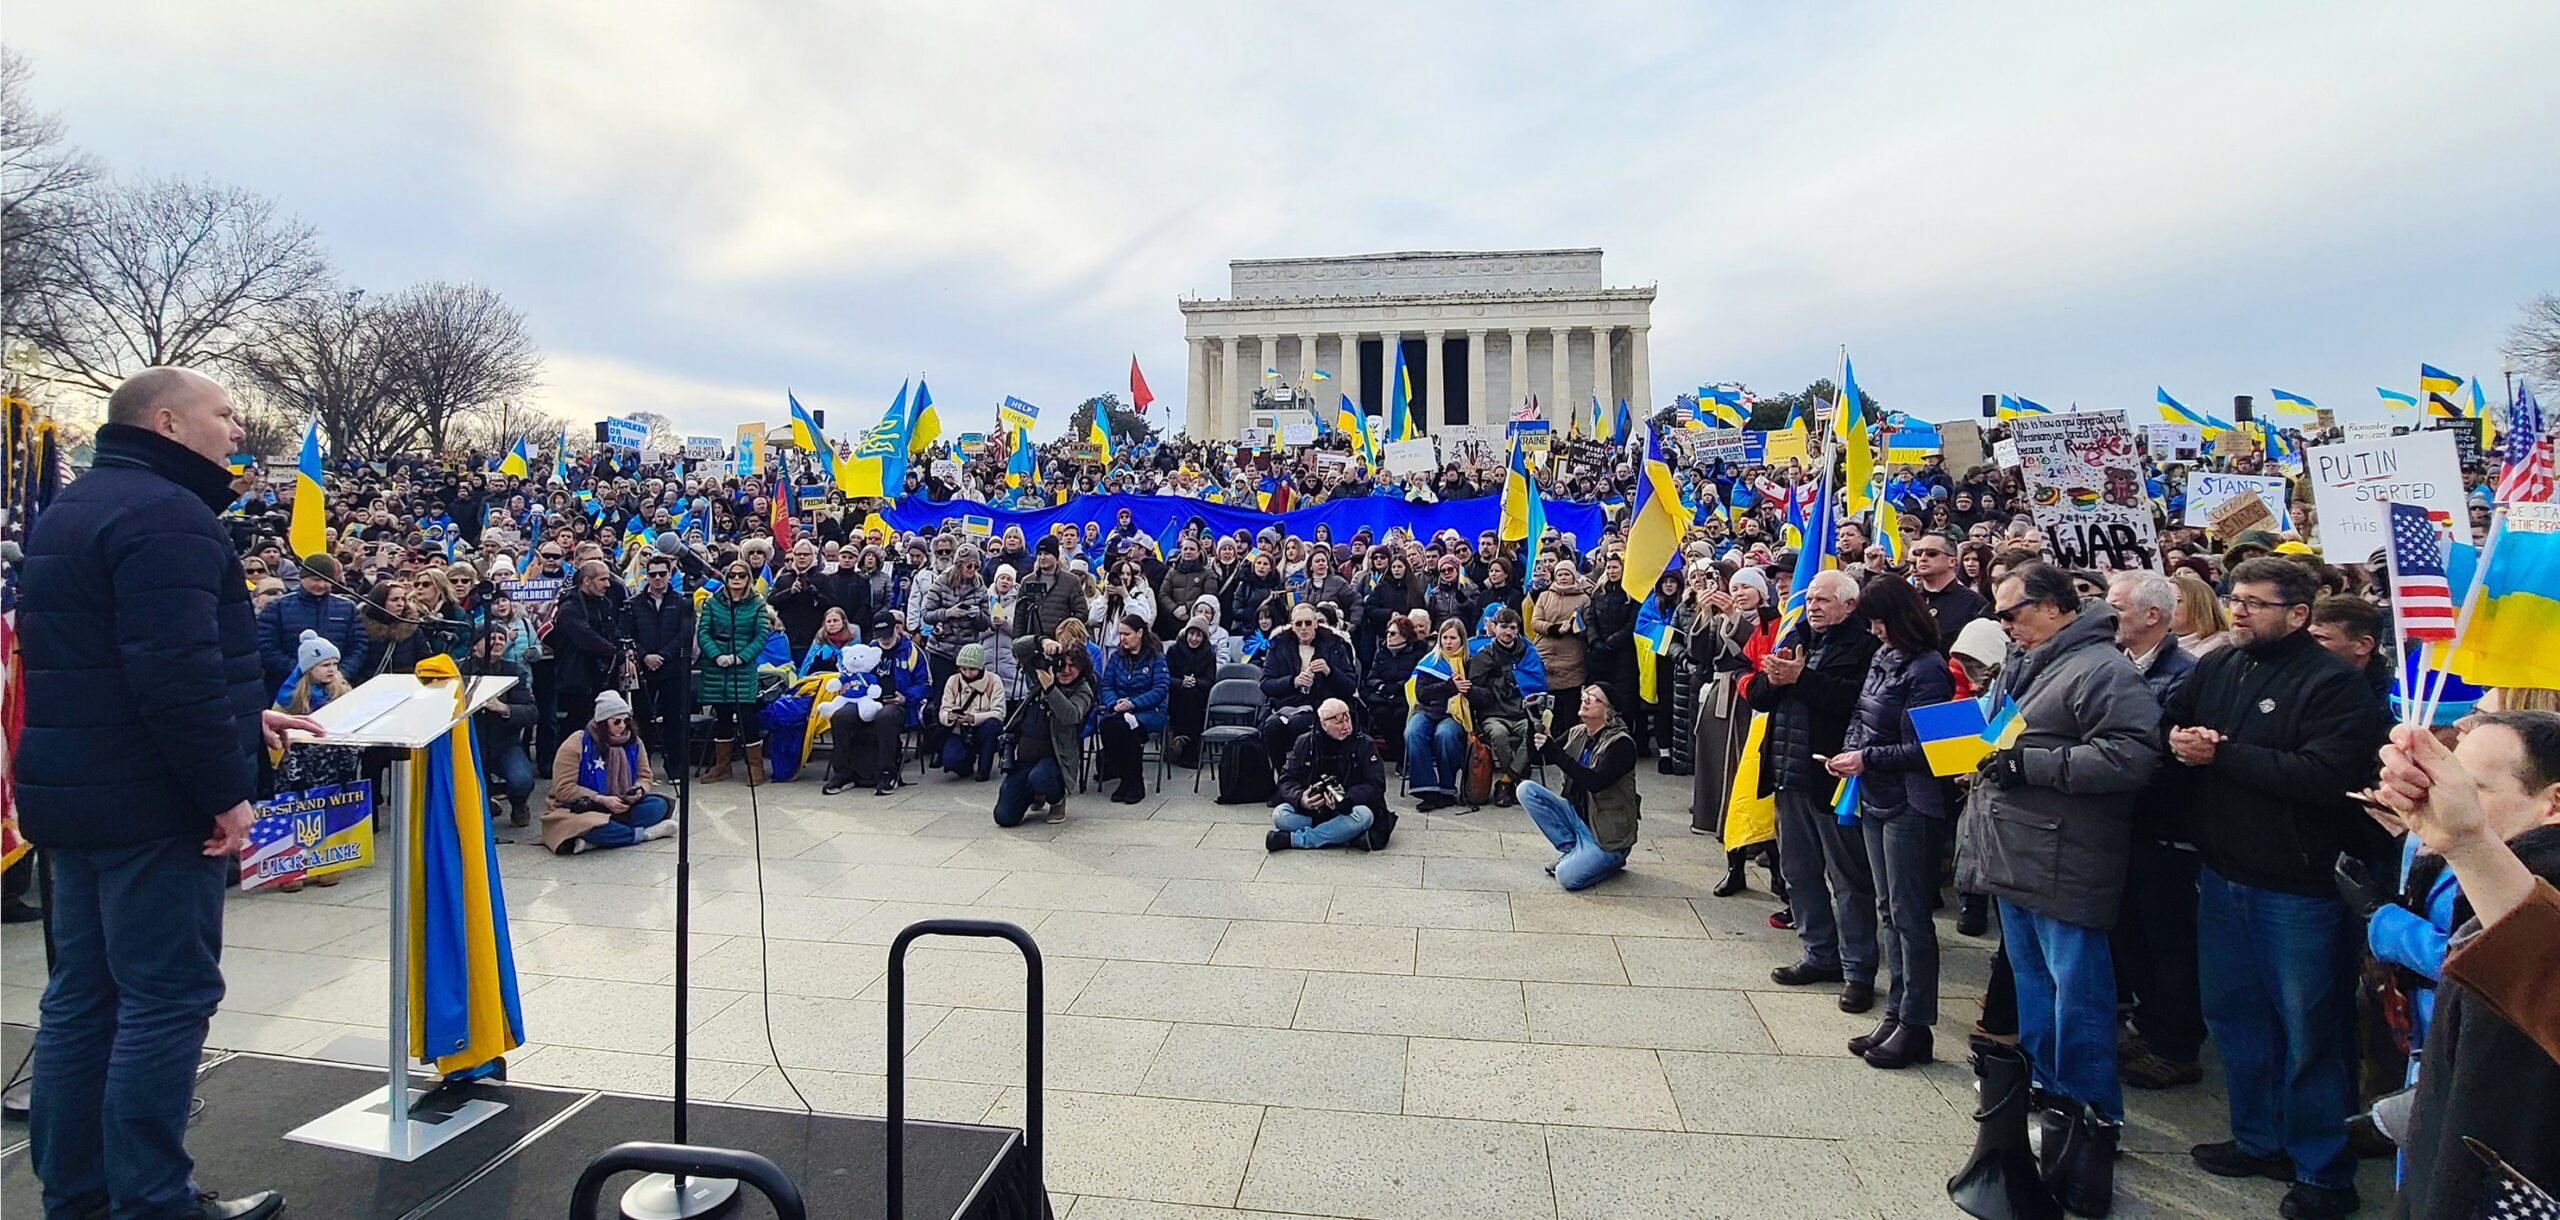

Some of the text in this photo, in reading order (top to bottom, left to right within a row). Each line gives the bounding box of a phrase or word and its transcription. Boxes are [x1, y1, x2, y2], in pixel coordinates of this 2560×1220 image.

[1012, 400, 1033, 413] HELP
[1008, 413, 1028, 424] THEM
[2009, 418, 2029, 430] This
[2030, 421, 2038, 429] is
[2037, 416, 2054, 428] how
[2062, 419, 2075, 427] new
[688, 438, 718, 446] UKRAINE
[1519, 436, 1547, 445] KRAINE
[688, 450, 721, 460] FOR SALE
[2319, 448, 2398, 483] PUTIN
[2197, 477, 2264, 496] STAND
[2355, 483, 2436, 502] STARTED
[2059, 513, 2130, 525] 2014-2025
[2340, 515, 2377, 535] this
[2046, 523, 2154, 570] WAR
[512, 590, 553, 600] CHILDREN!
[275, 797, 326, 816] STAND
[329, 790, 365, 806] WITH
[257, 842, 362, 878] UKRAINE
